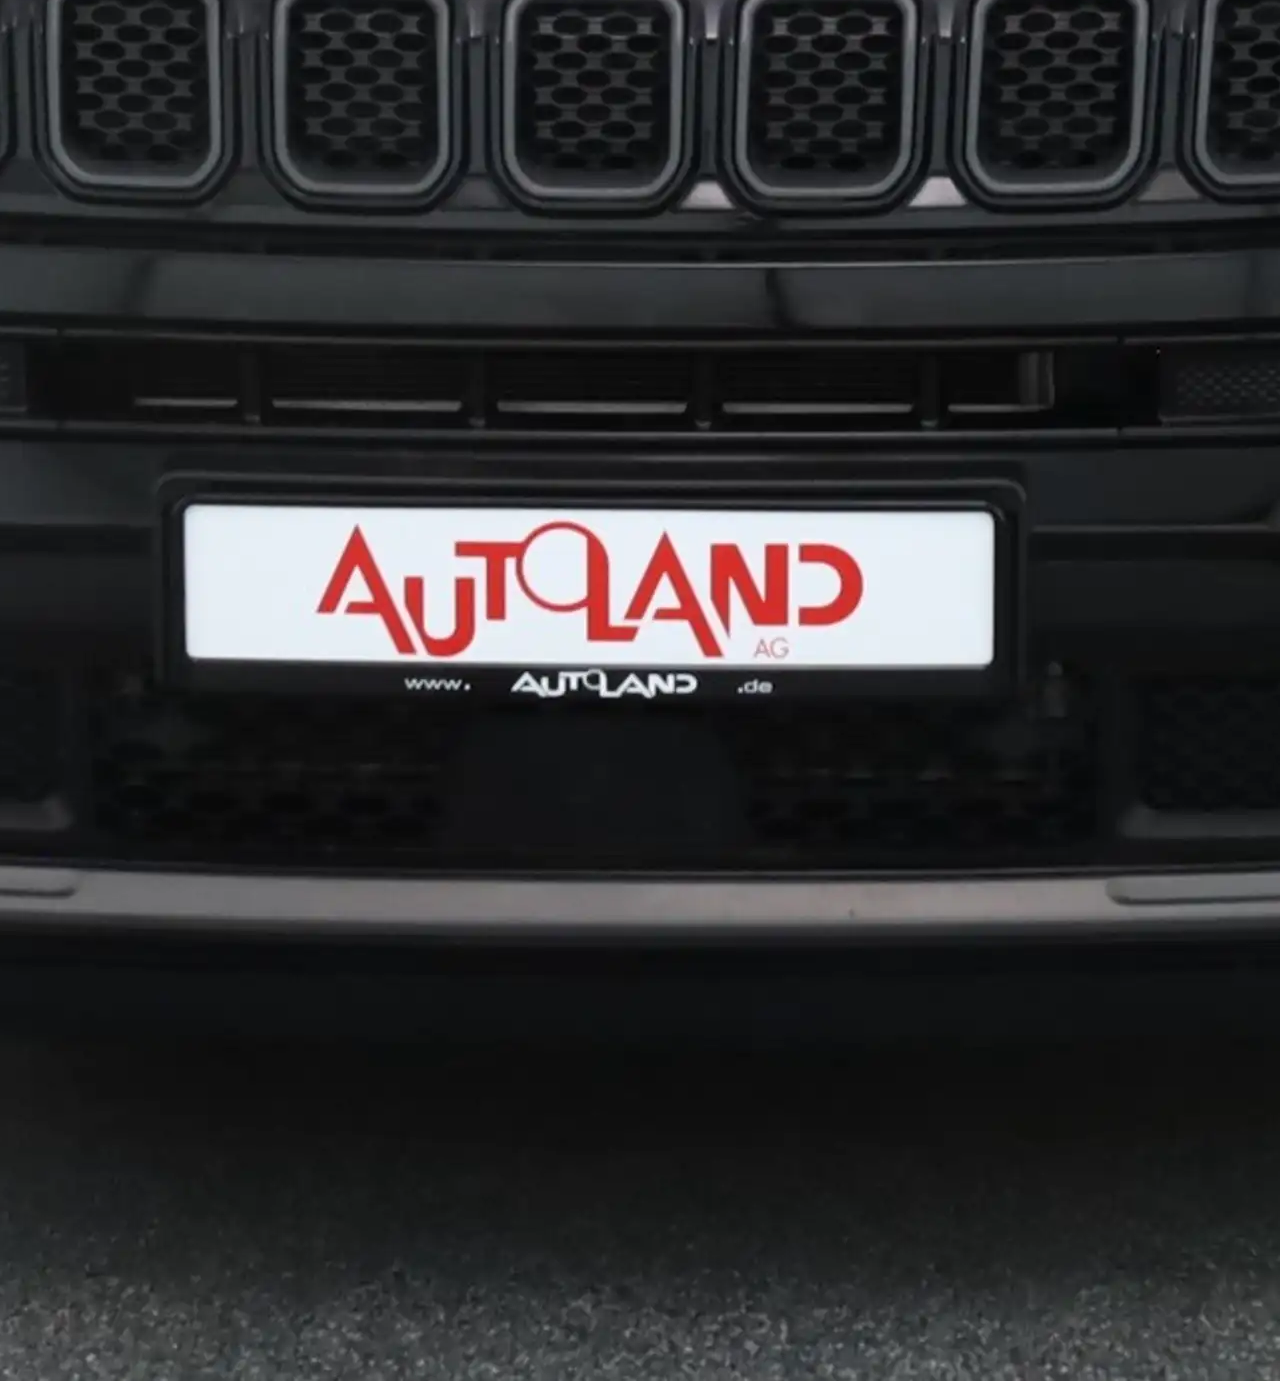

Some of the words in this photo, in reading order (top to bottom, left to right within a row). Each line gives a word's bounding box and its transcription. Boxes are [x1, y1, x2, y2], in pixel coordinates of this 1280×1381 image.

[316, 521, 863, 657] AUTOLAND
[753, 638, 789, 659] AG
[404, 677, 471, 692] www.
[510, 669, 698, 699] AUTOLAND
[737, 677, 773, 694] .de
